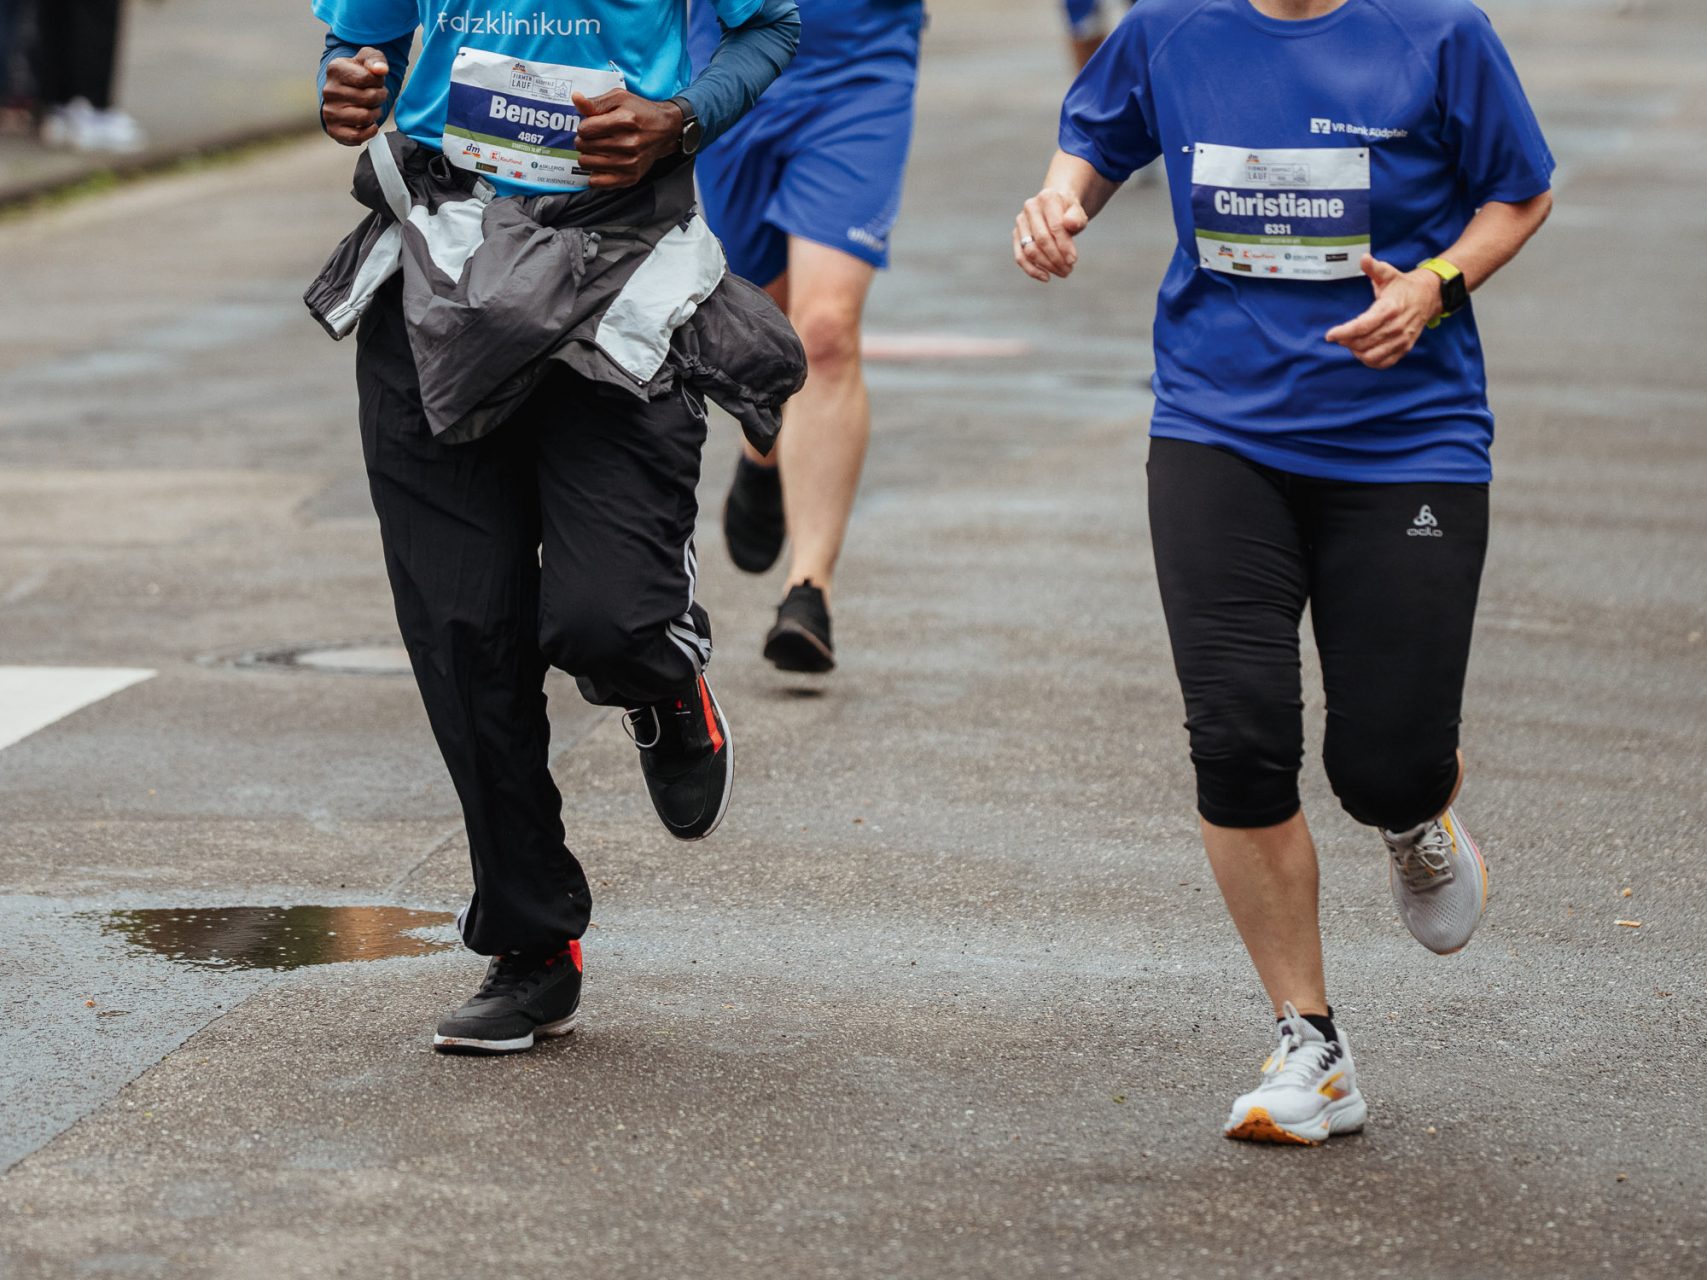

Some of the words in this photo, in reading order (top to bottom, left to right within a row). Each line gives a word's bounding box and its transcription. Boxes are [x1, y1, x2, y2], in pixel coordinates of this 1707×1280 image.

[438, 10, 601, 36] falzklinikum
[511, 79, 531, 90] LAUF
[489, 95, 581, 133] Benson
[1331, 122, 1346, 133] VR
[1346, 123, 1369, 136] Bank
[518, 131, 544, 145] 4867
[466, 143, 481, 153] dm
[1214, 190, 1345, 218] Christiane
[1264, 223, 1291, 235] 6331
